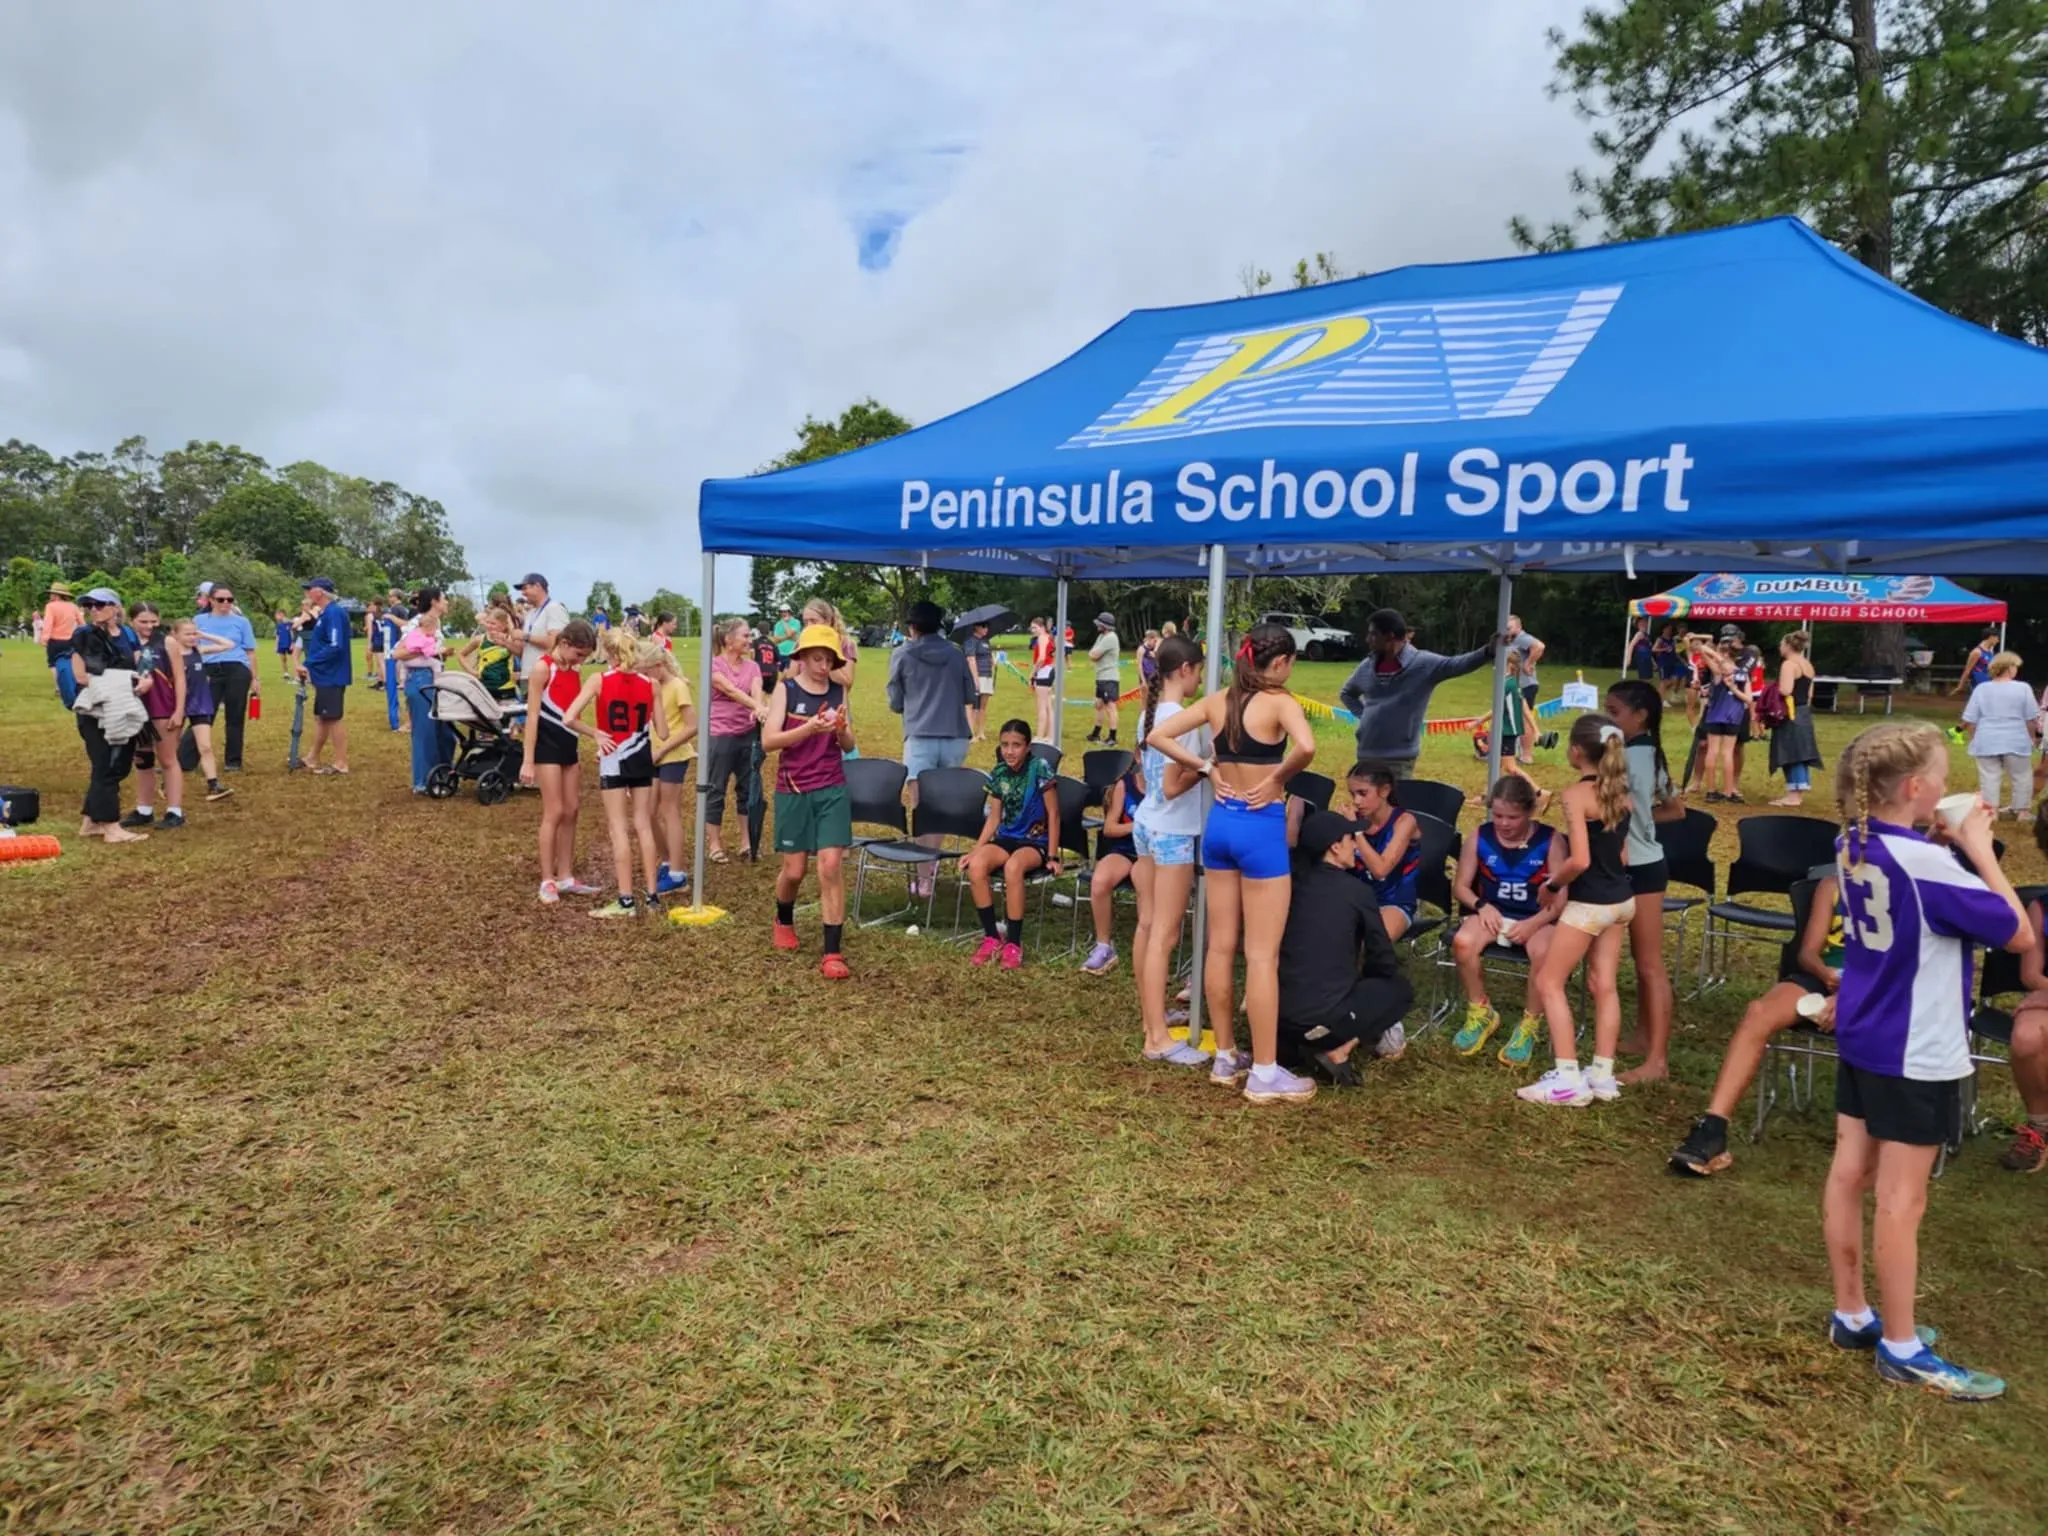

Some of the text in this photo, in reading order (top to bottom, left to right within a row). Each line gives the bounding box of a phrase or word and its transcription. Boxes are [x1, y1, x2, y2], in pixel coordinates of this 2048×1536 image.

[901, 443, 1694, 533] Peninsula School Sport
[1753, 577, 1869, 595] DUMBUL
[1693, 604, 1929, 619] WOREE STATE HIGH SCHOOL
[608, 700, 648, 732] 81
[1497, 881, 1528, 901] 25
